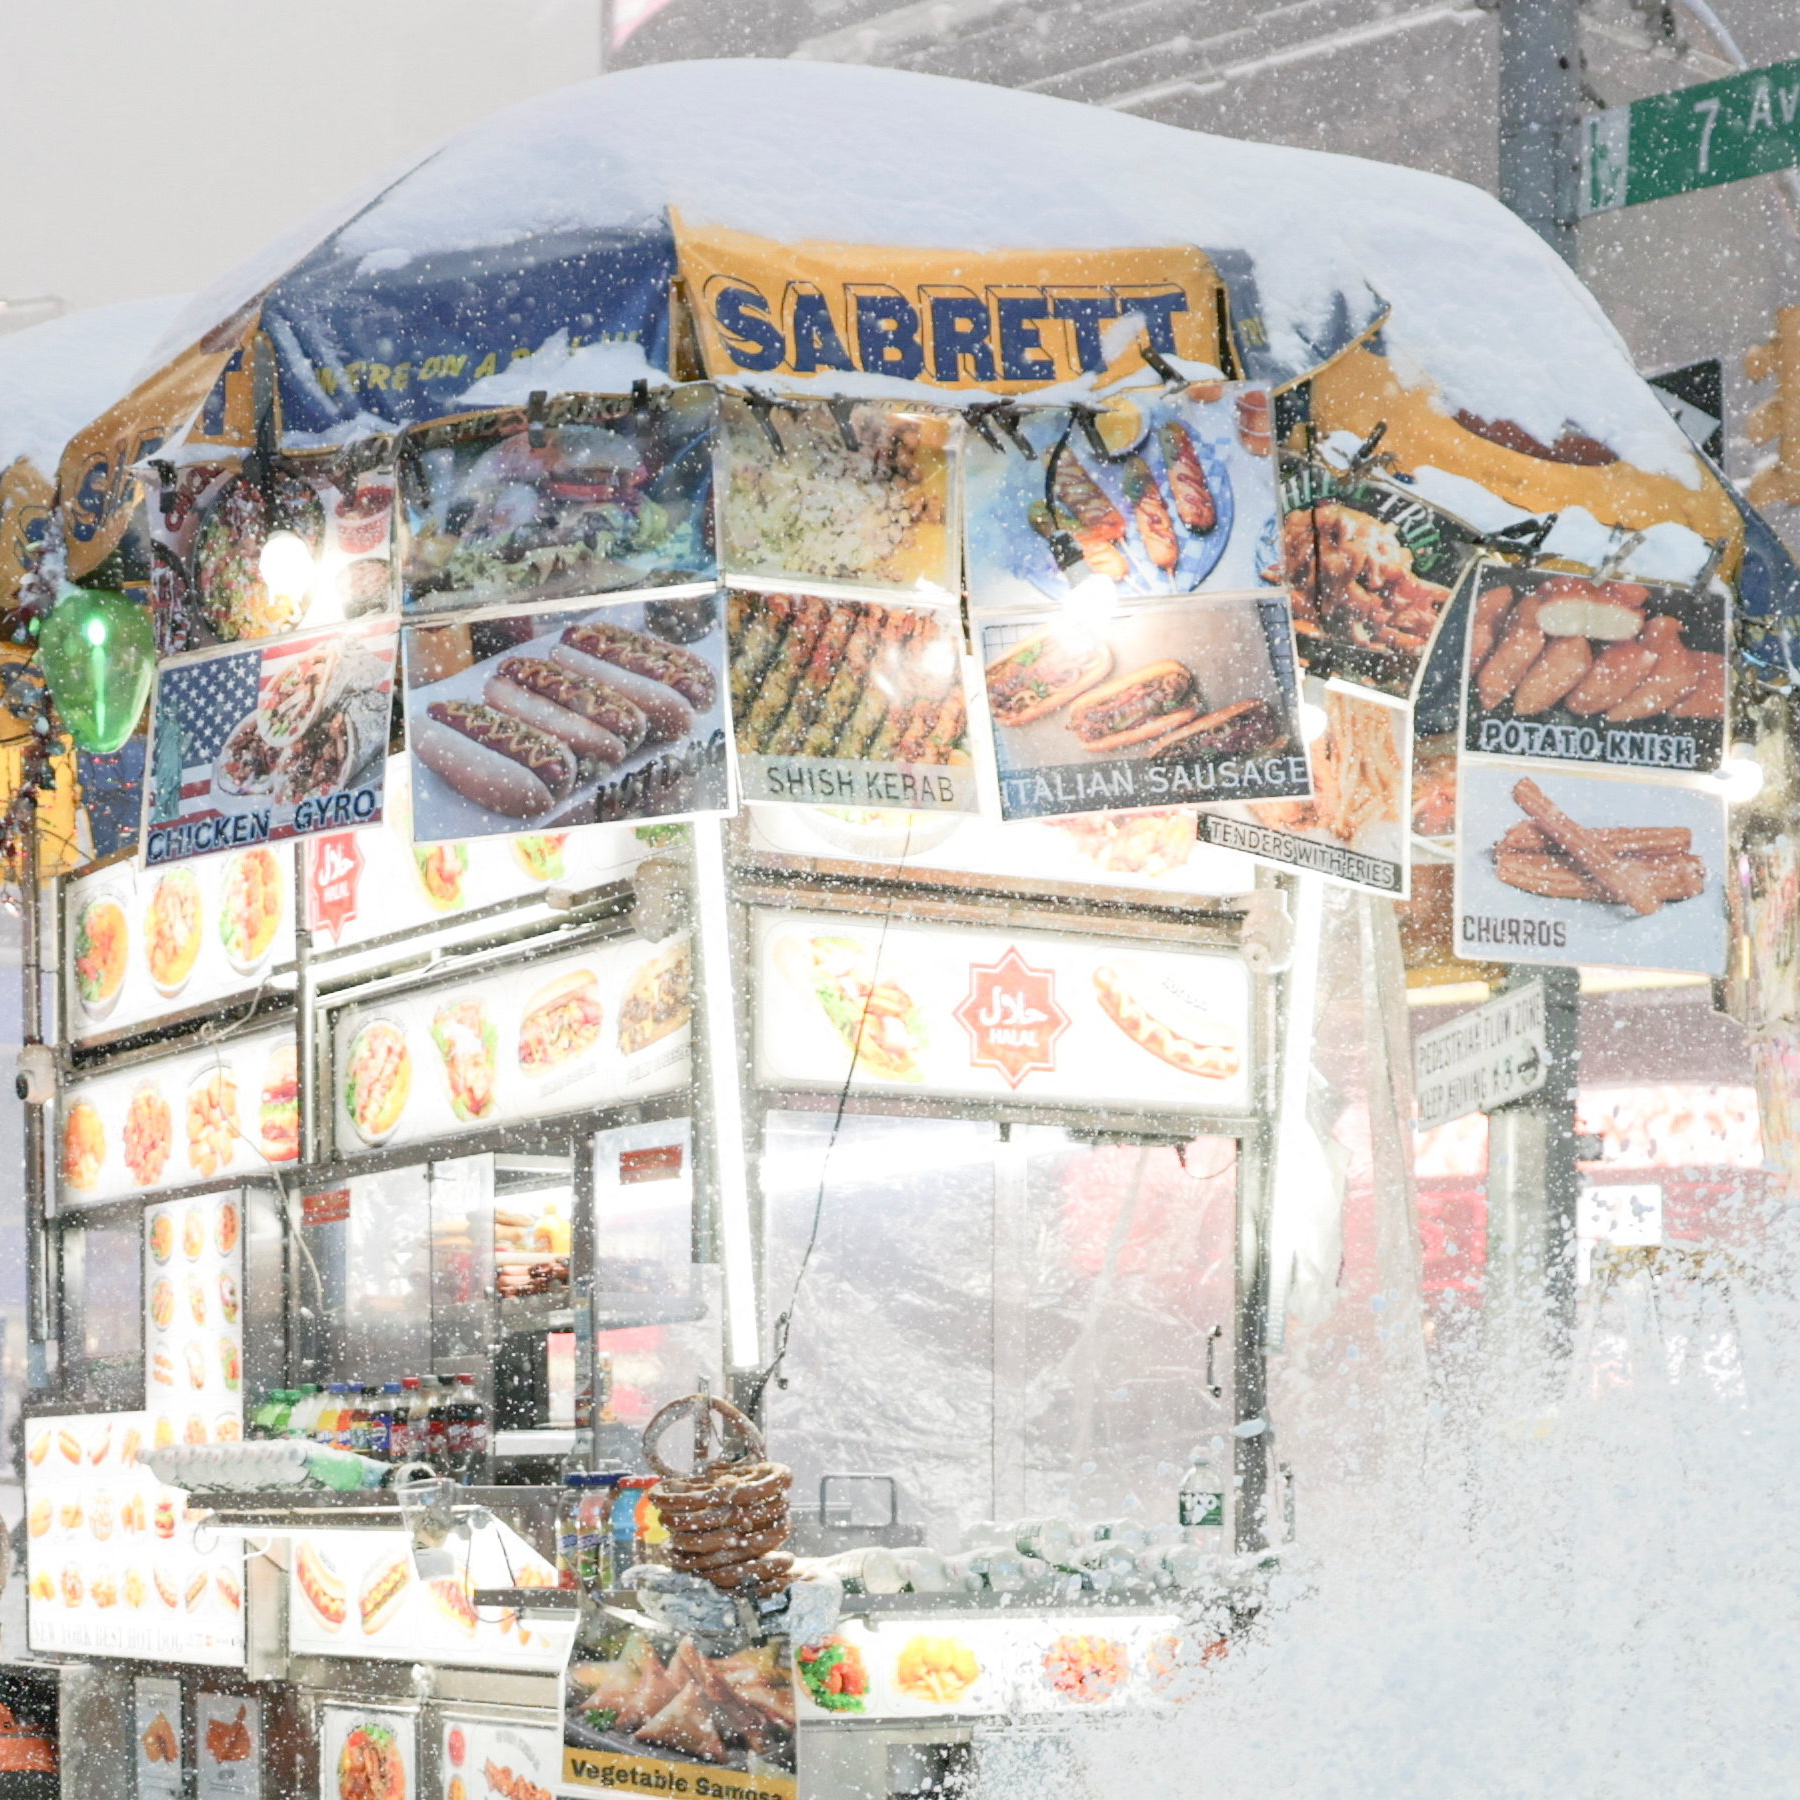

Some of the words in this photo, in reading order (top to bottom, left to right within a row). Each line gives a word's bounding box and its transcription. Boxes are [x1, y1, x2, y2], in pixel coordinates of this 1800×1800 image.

[1694, 97, 1720, 173] 7
[1748, 82, 1799, 133] AV
[703, 277, 1188, 383] SABRETT
[417, 354, 467, 381] ON
[1481, 719, 1598, 759] POTATO
[1607, 730, 1696, 767] KNISH
[766, 766, 852, 798] SHISH
[865, 770, 955, 803] KEBAB
[1001, 767, 1134, 808] ITALIAN
[1146, 757, 1311, 794] SAUSAGE
[147, 808, 270, 863] CHICKEN
[293, 788, 378, 834] GYRO
[1210, 820, 1294, 860] TENDERS
[1297, 843, 1343, 873] WITH
[1346, 855, 1394, 886] FRIES
[1462, 914, 1567, 947] CHURROS
[988, 1026, 1039, 1048] HALAL
[60, 1621, 92, 1647] YORK
[95, 1624, 124, 1649] BEST
[127, 1627, 152, 1651] HOT
[570, 1757, 689, 1794] Vegetable
